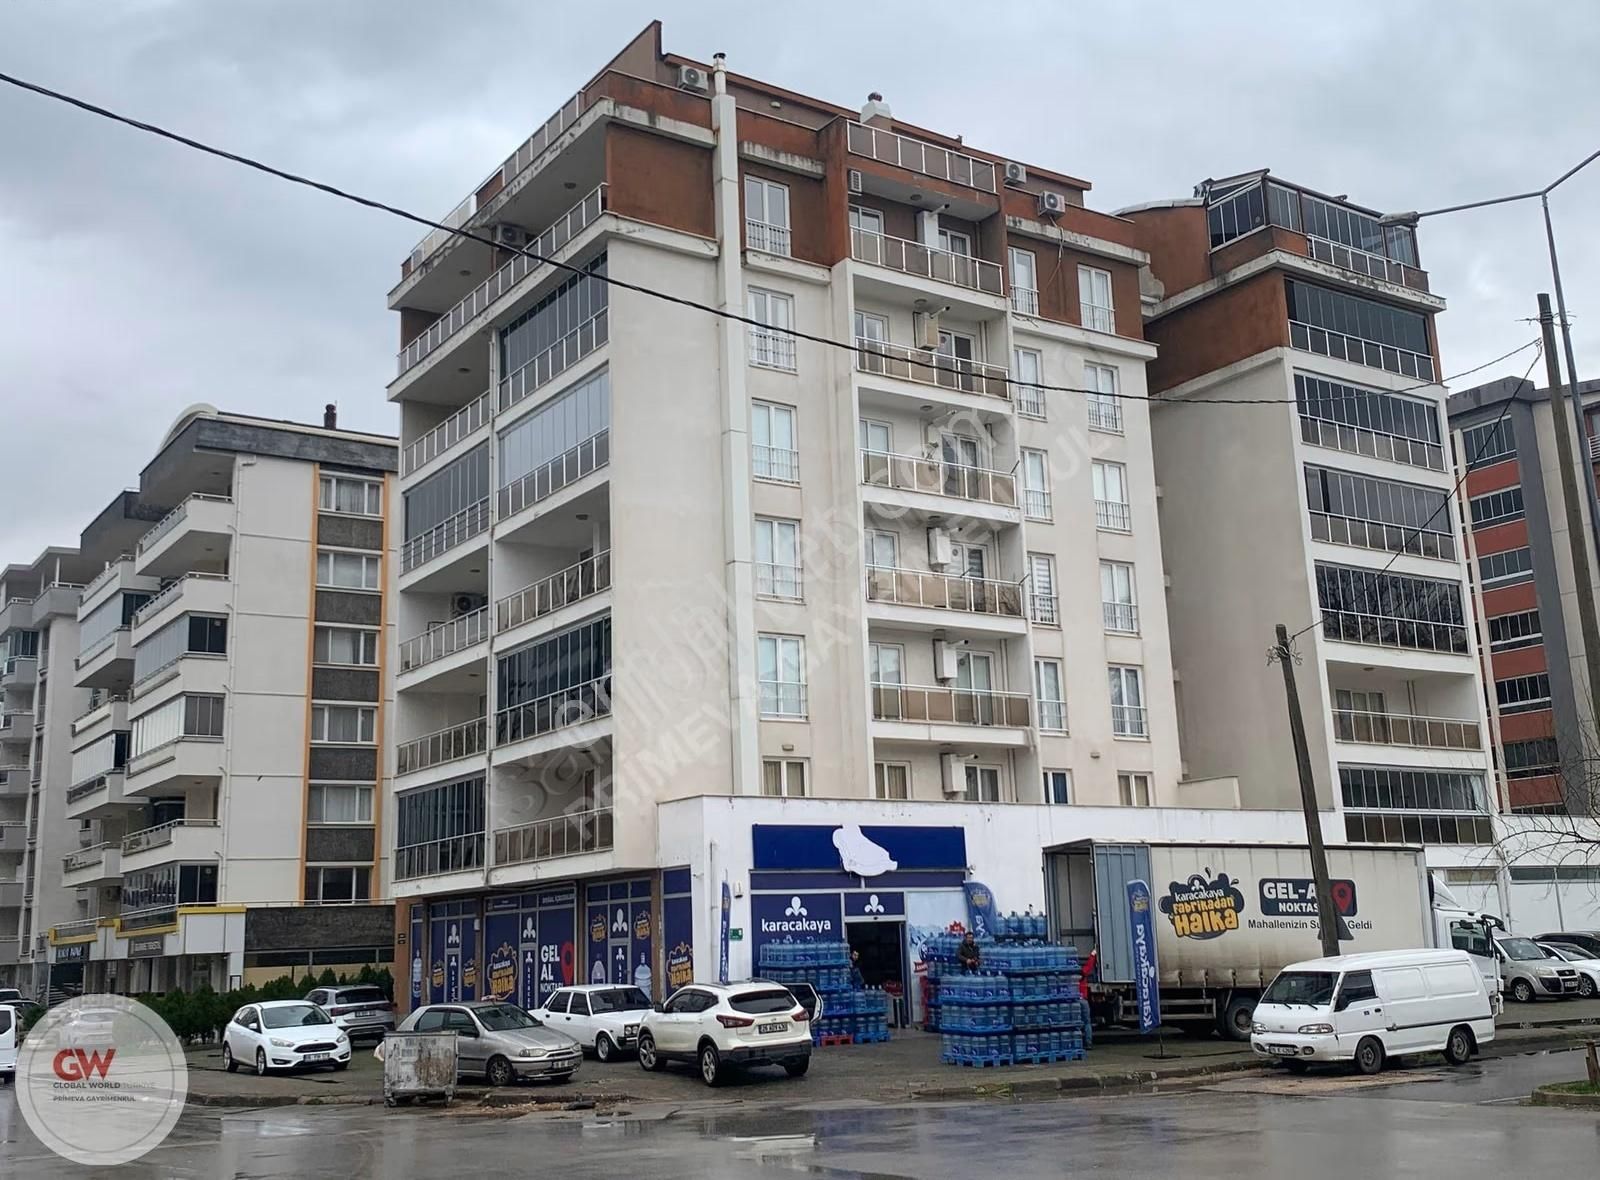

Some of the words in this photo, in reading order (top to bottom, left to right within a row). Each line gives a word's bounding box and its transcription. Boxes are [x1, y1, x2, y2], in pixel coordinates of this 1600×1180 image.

[1175, 888, 1224, 902] karacakaya
[1263, 882, 1318, 900] GEL-A
[1279, 902, 1319, 913] NOKTAS
[761, 917, 832, 934] karacakaya
[1174, 908, 1238, 936] Halka
[1248, 919, 1308, 929] Mahallenizin
[1347, 920, 1373, 930] Geldi
[541, 945, 561, 962] GEL
[541, 964, 554, 981] AL
[1136, 924, 1153, 1027] karacakaya
